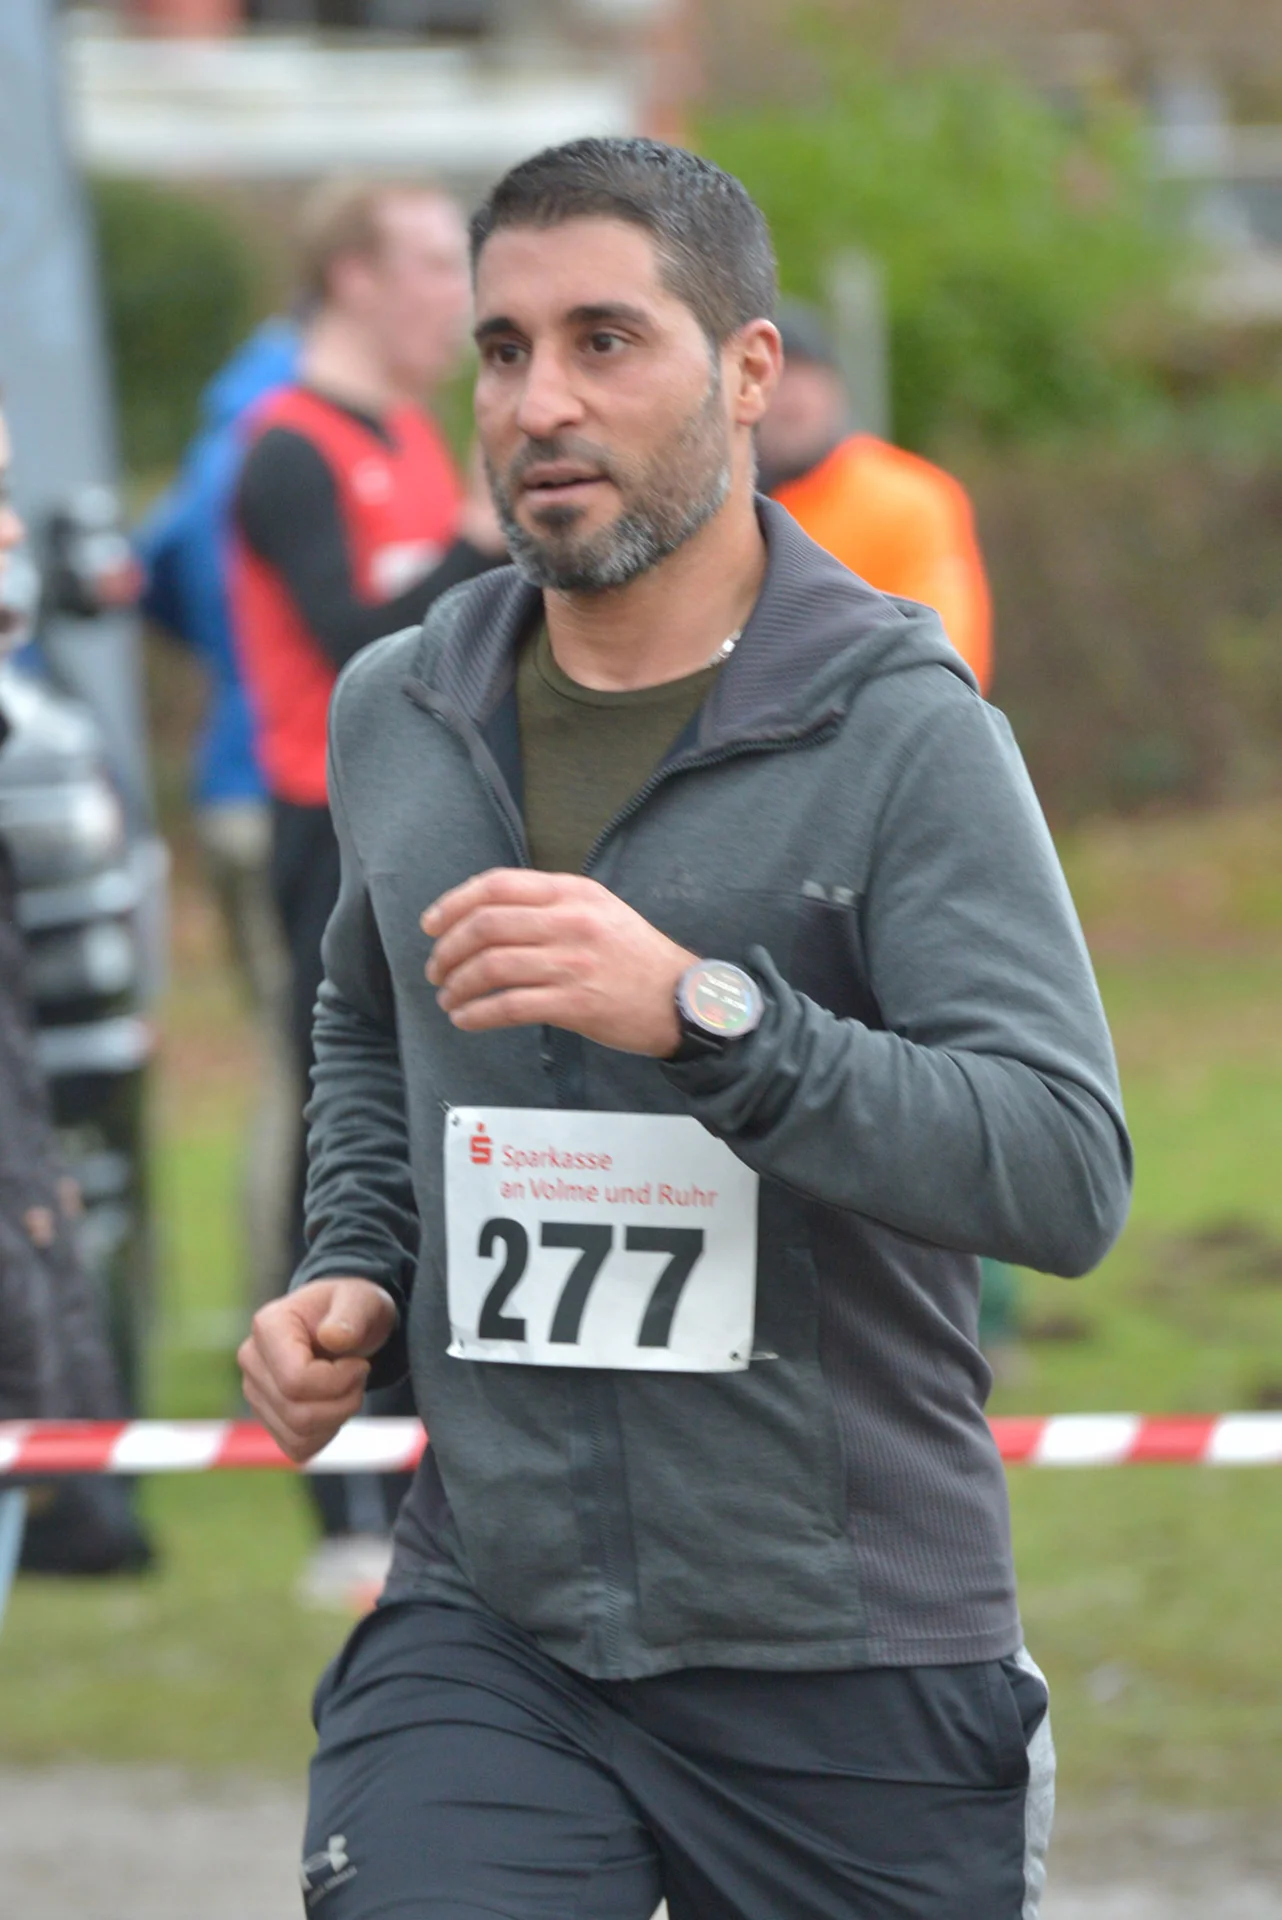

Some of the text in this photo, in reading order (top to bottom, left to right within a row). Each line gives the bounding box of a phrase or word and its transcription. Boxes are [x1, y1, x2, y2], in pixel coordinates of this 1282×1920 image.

[501, 1146, 612, 1171] Sparkasse
[500, 1179, 718, 1207] an Volme und Ruhr
[477, 1217, 705, 1349] 277
